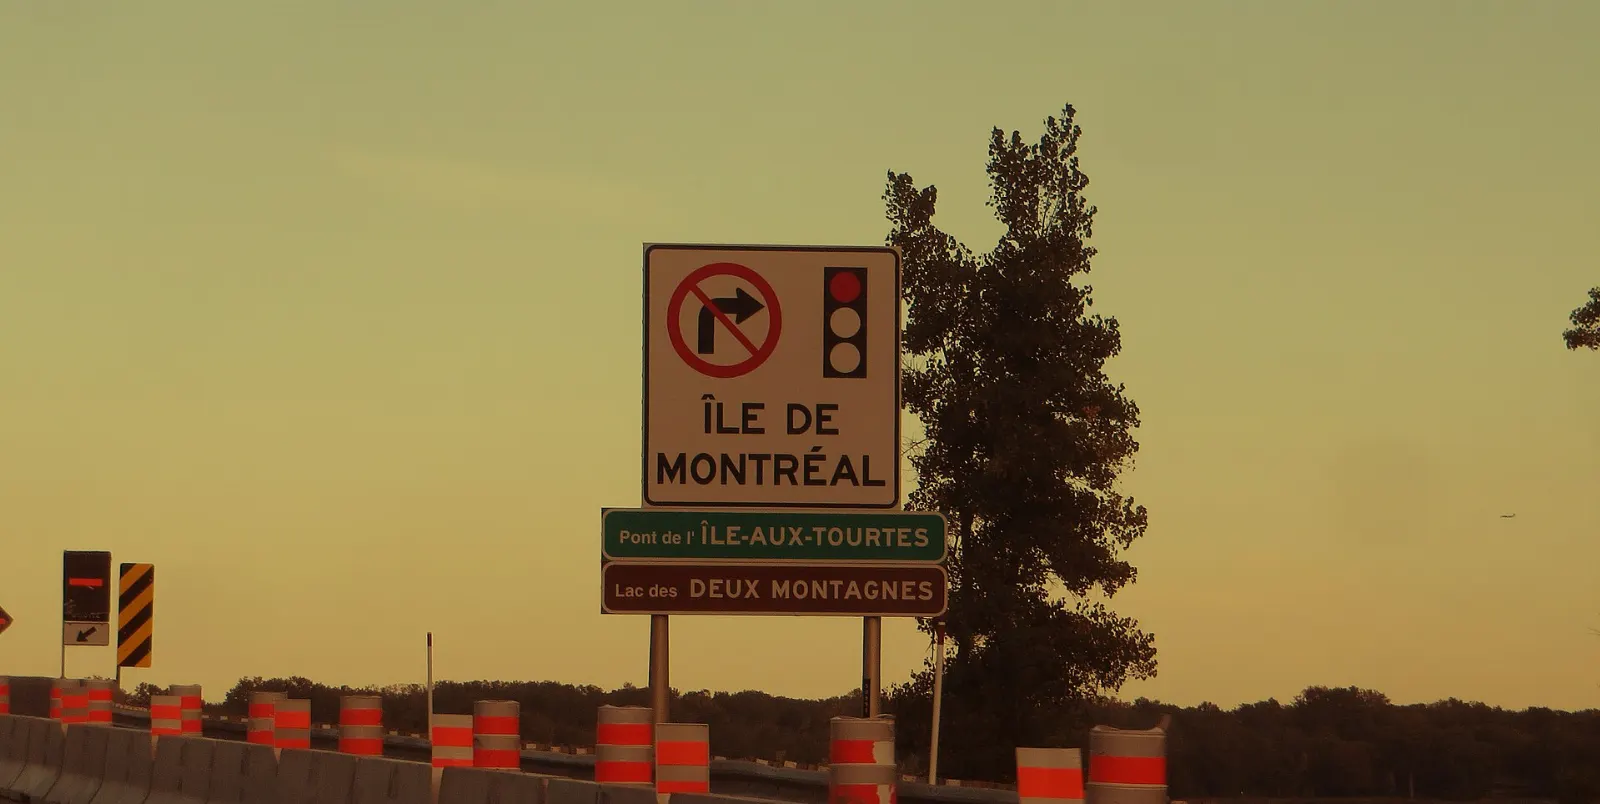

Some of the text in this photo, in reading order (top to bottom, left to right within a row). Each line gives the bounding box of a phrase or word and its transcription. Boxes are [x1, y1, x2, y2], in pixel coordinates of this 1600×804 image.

[701, 394, 839, 435] ÎLE DE
[657, 446, 886, 486] MONTRÉAL
[619, 530, 657, 545] Pont
[661, 530, 682, 545] de
[701, 520, 929, 547] ÎLE-AUX-TOURTES
[615, 578, 934, 600] Lac des DEUX MONTAGNES
